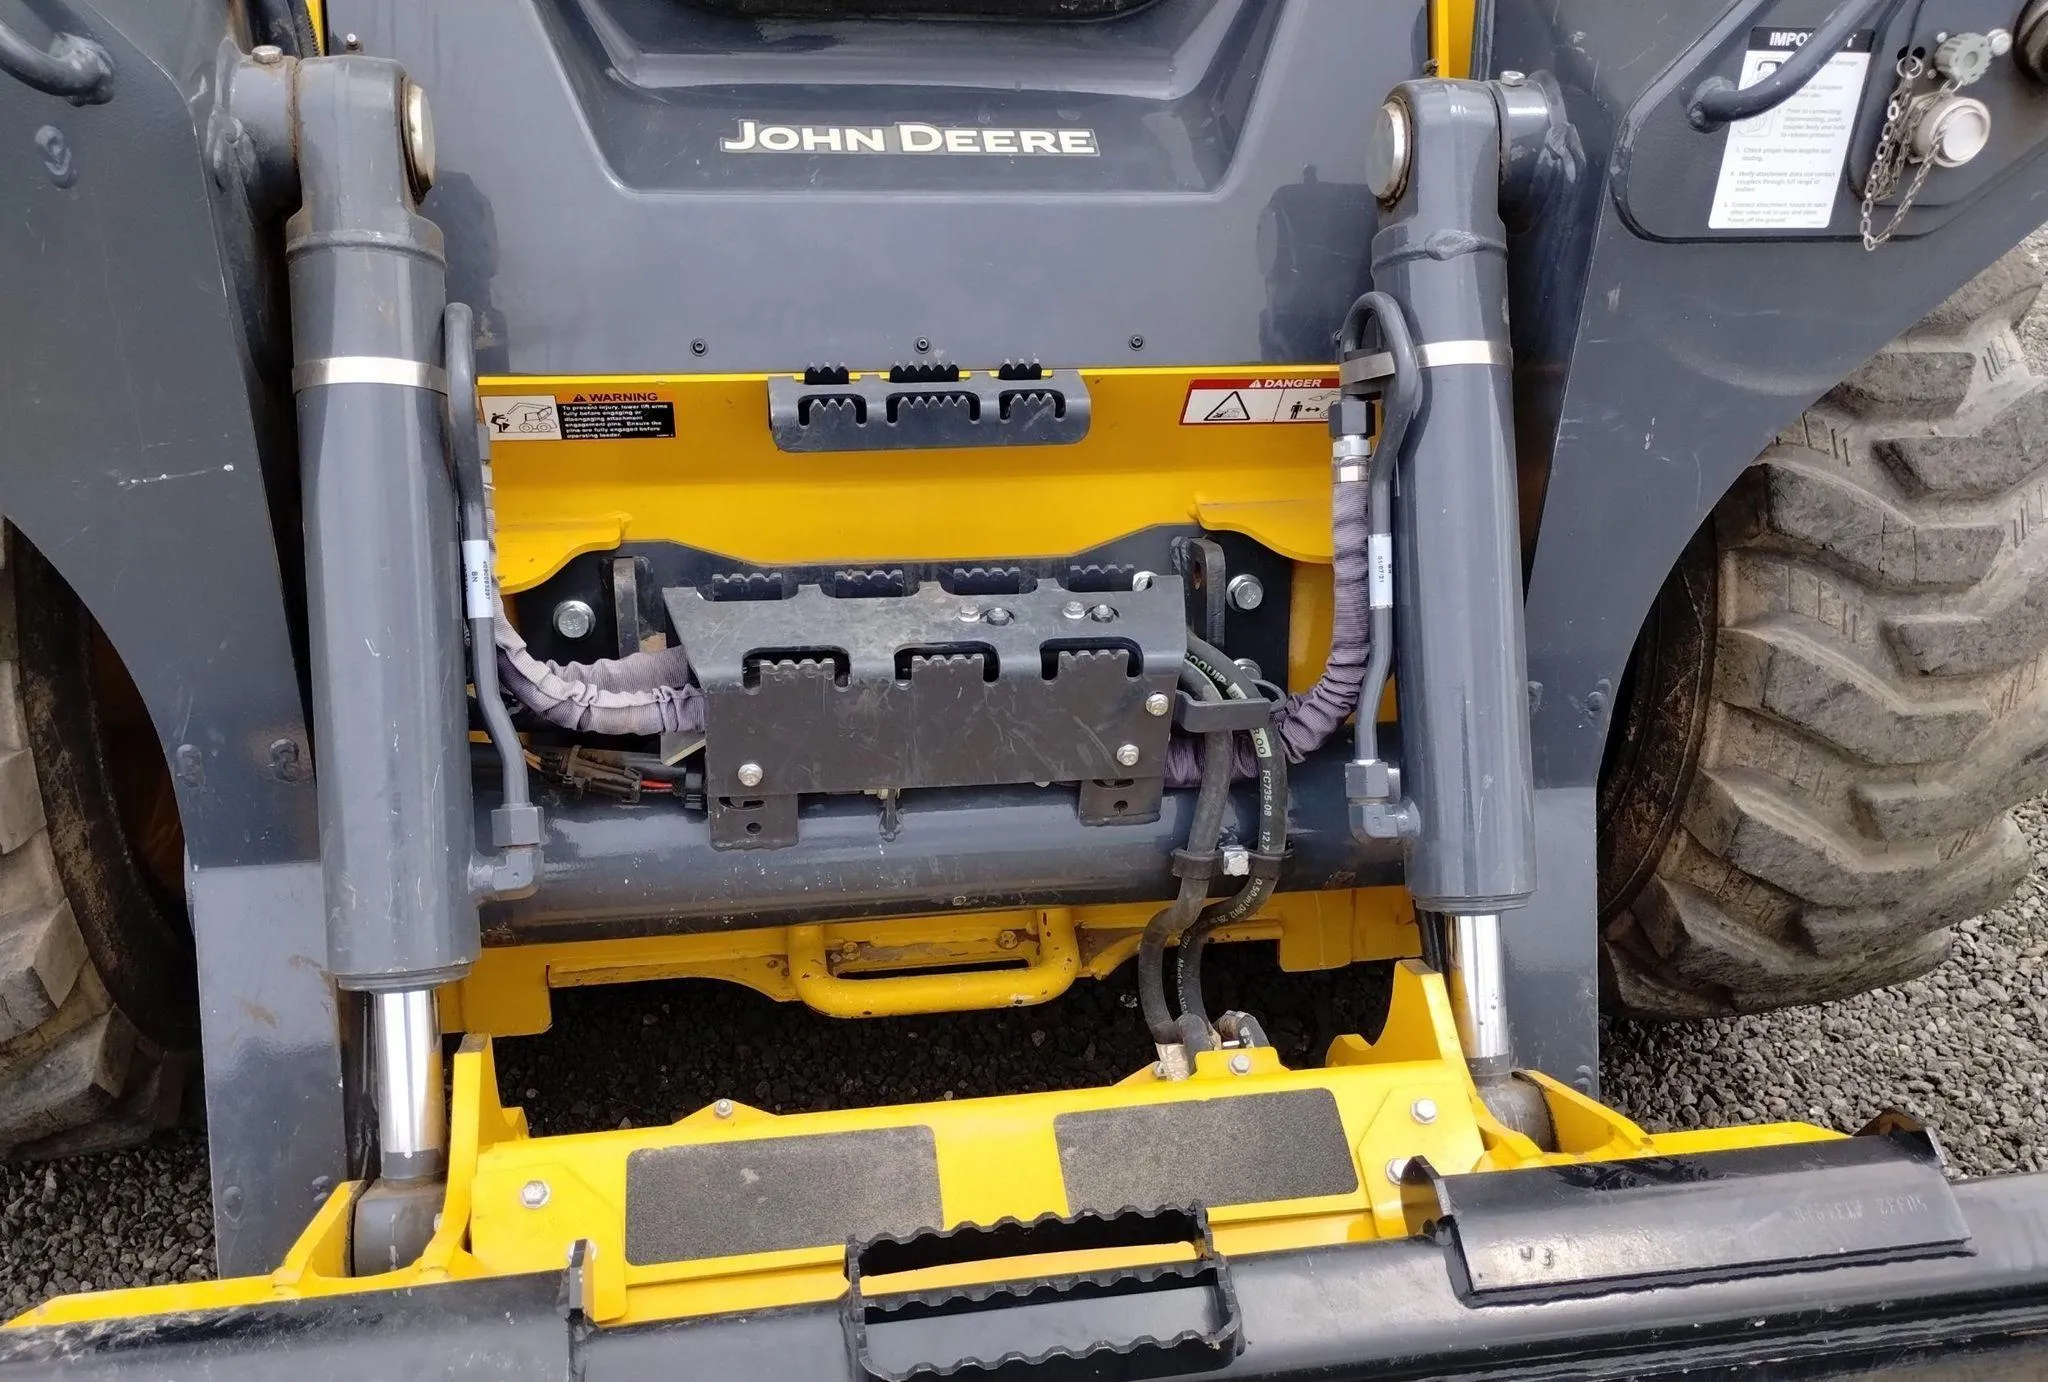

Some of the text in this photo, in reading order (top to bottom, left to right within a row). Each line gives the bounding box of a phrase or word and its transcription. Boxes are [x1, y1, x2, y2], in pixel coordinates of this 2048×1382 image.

[724, 122, 1095, 153] JOHN DEERE
[1264, 379, 1322, 388] DANGER
[589, 393, 658, 402] WARNING
